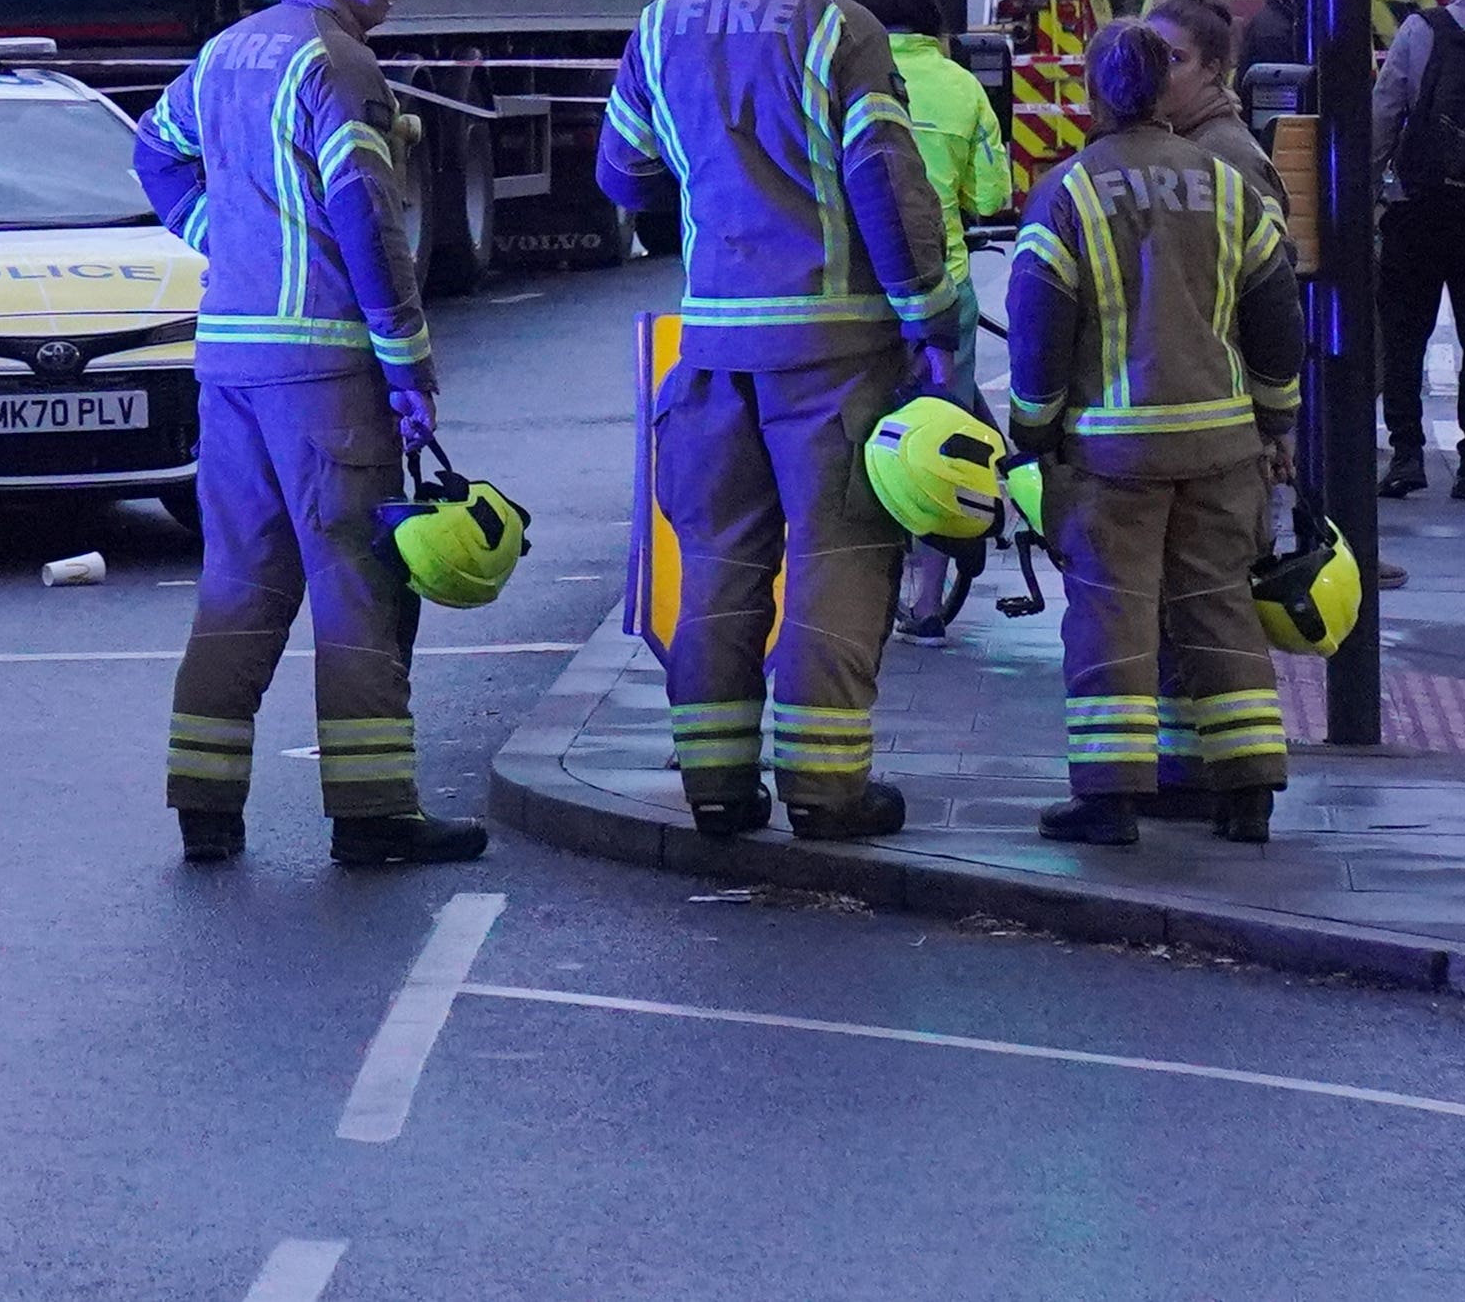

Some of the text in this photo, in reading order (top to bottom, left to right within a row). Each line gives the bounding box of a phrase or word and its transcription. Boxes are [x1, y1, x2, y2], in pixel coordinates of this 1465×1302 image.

[206, 32, 294, 71] FIRE
[1092, 165, 1215, 216] FIRE
[493, 232, 602, 253] VOLVO
[78, 396, 134, 427] PLV
